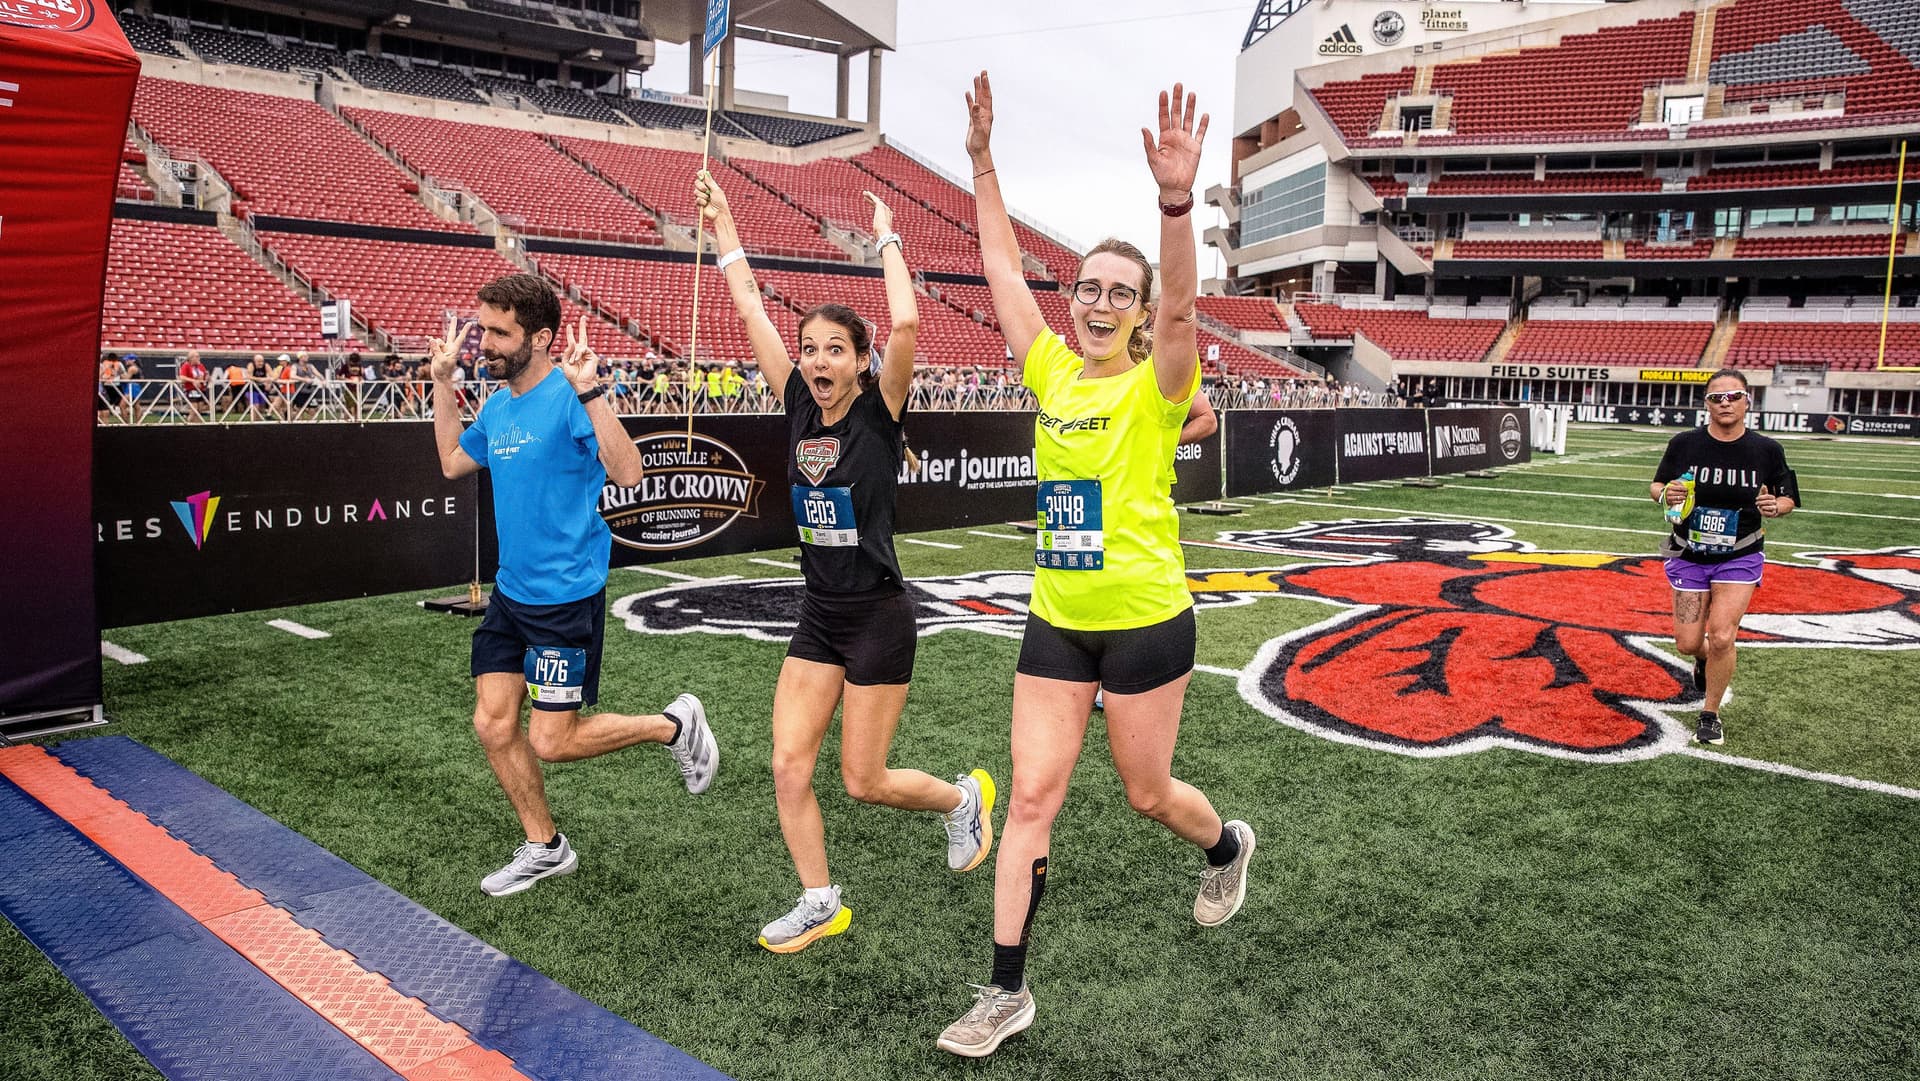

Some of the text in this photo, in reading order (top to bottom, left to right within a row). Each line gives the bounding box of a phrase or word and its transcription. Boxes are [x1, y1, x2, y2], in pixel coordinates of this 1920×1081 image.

[1422, 8, 1462, 20] planet
[1426, 20, 1468, 29] fitness
[1319, 42, 1363, 54] adidas
[1491, 365, 1609, 380] FIELD SUITES
[1642, 370, 1673, 381] MORGAN
[1577, 405, 1619, 423] VILLE.
[1764, 412, 1813, 433] VILLE.
[1865, 421, 1911, 430] STOCKTON
[1451, 425, 1480, 444] NORTON
[1344, 431, 1424, 457] AGAINST THE GRAIN
[1452, 444, 1469, 457] SPORTS
[642, 451, 708, 468] OUISVILLE
[898, 448, 1037, 487] urier journal
[1690, 465, 1758, 489] NOBULL
[596, 473, 750, 513] RIPLE CROWN
[228, 496, 456, 532] ENDURANCE
[641, 509, 701, 523] OF RUNNING
[803, 499, 837, 525] 1203
[1045, 495, 1084, 525] 3448
[1699, 514, 1726, 533] 1986
[641, 524, 701, 541] courier journal
[1044, 535, 1049, 546] C
[535, 657, 569, 682] 1476
[531, 687, 537, 697] A
